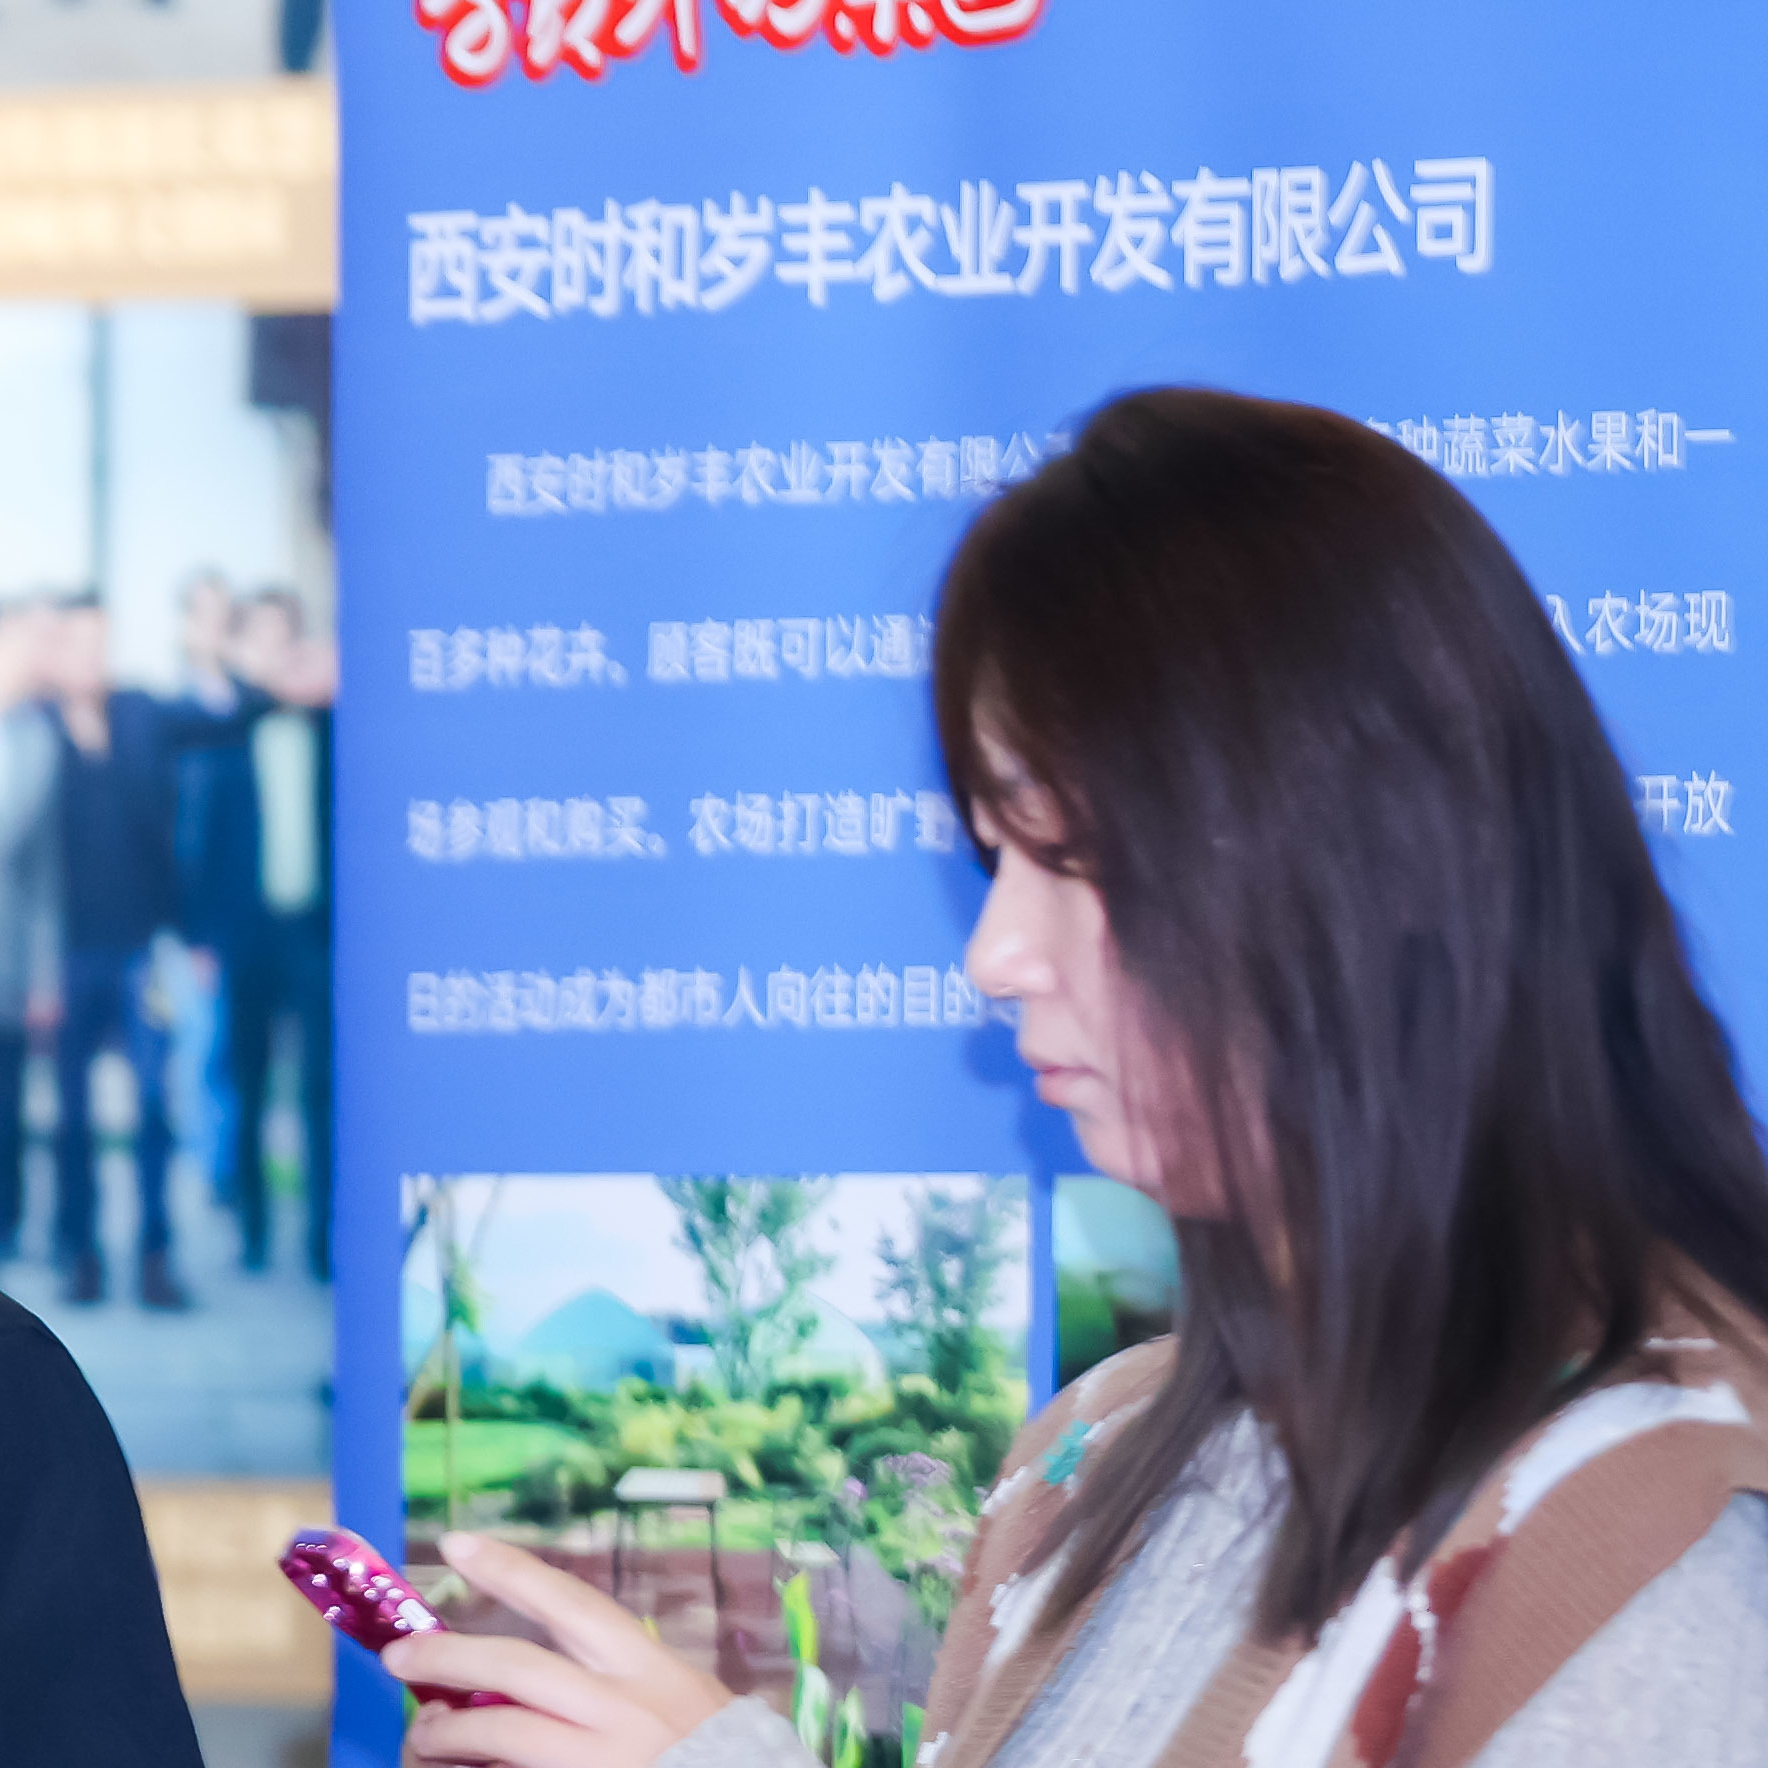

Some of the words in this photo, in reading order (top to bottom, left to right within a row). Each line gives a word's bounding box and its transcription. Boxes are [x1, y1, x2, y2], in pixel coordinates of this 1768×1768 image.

[407, 155, 1497, 326] 西安时和岁丰农业开发有限公司
[1365, 406, 1737, 478] 种蔬菜水果和一
[1631, 768, 1735, 838] 开放
